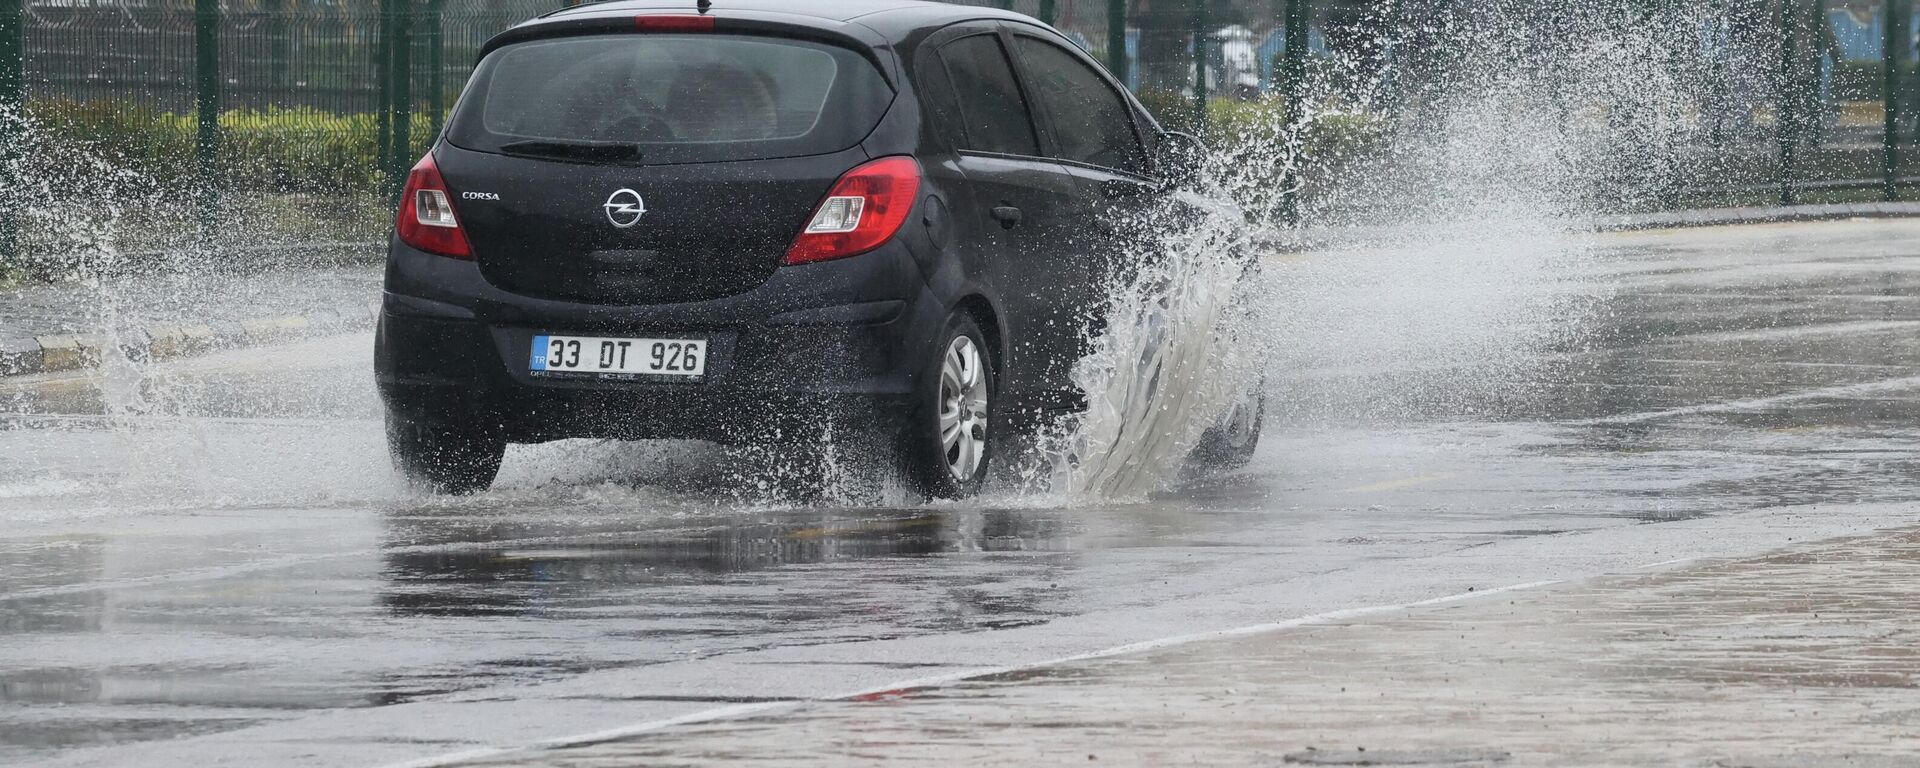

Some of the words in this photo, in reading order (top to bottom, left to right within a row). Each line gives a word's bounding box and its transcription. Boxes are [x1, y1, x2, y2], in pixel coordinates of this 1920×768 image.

[462, 191, 500, 200] CORSA
[534, 355, 546, 365] TR
[549, 339, 581, 368] 33
[599, 341, 631, 369] DT
[650, 342, 698, 371] 926
